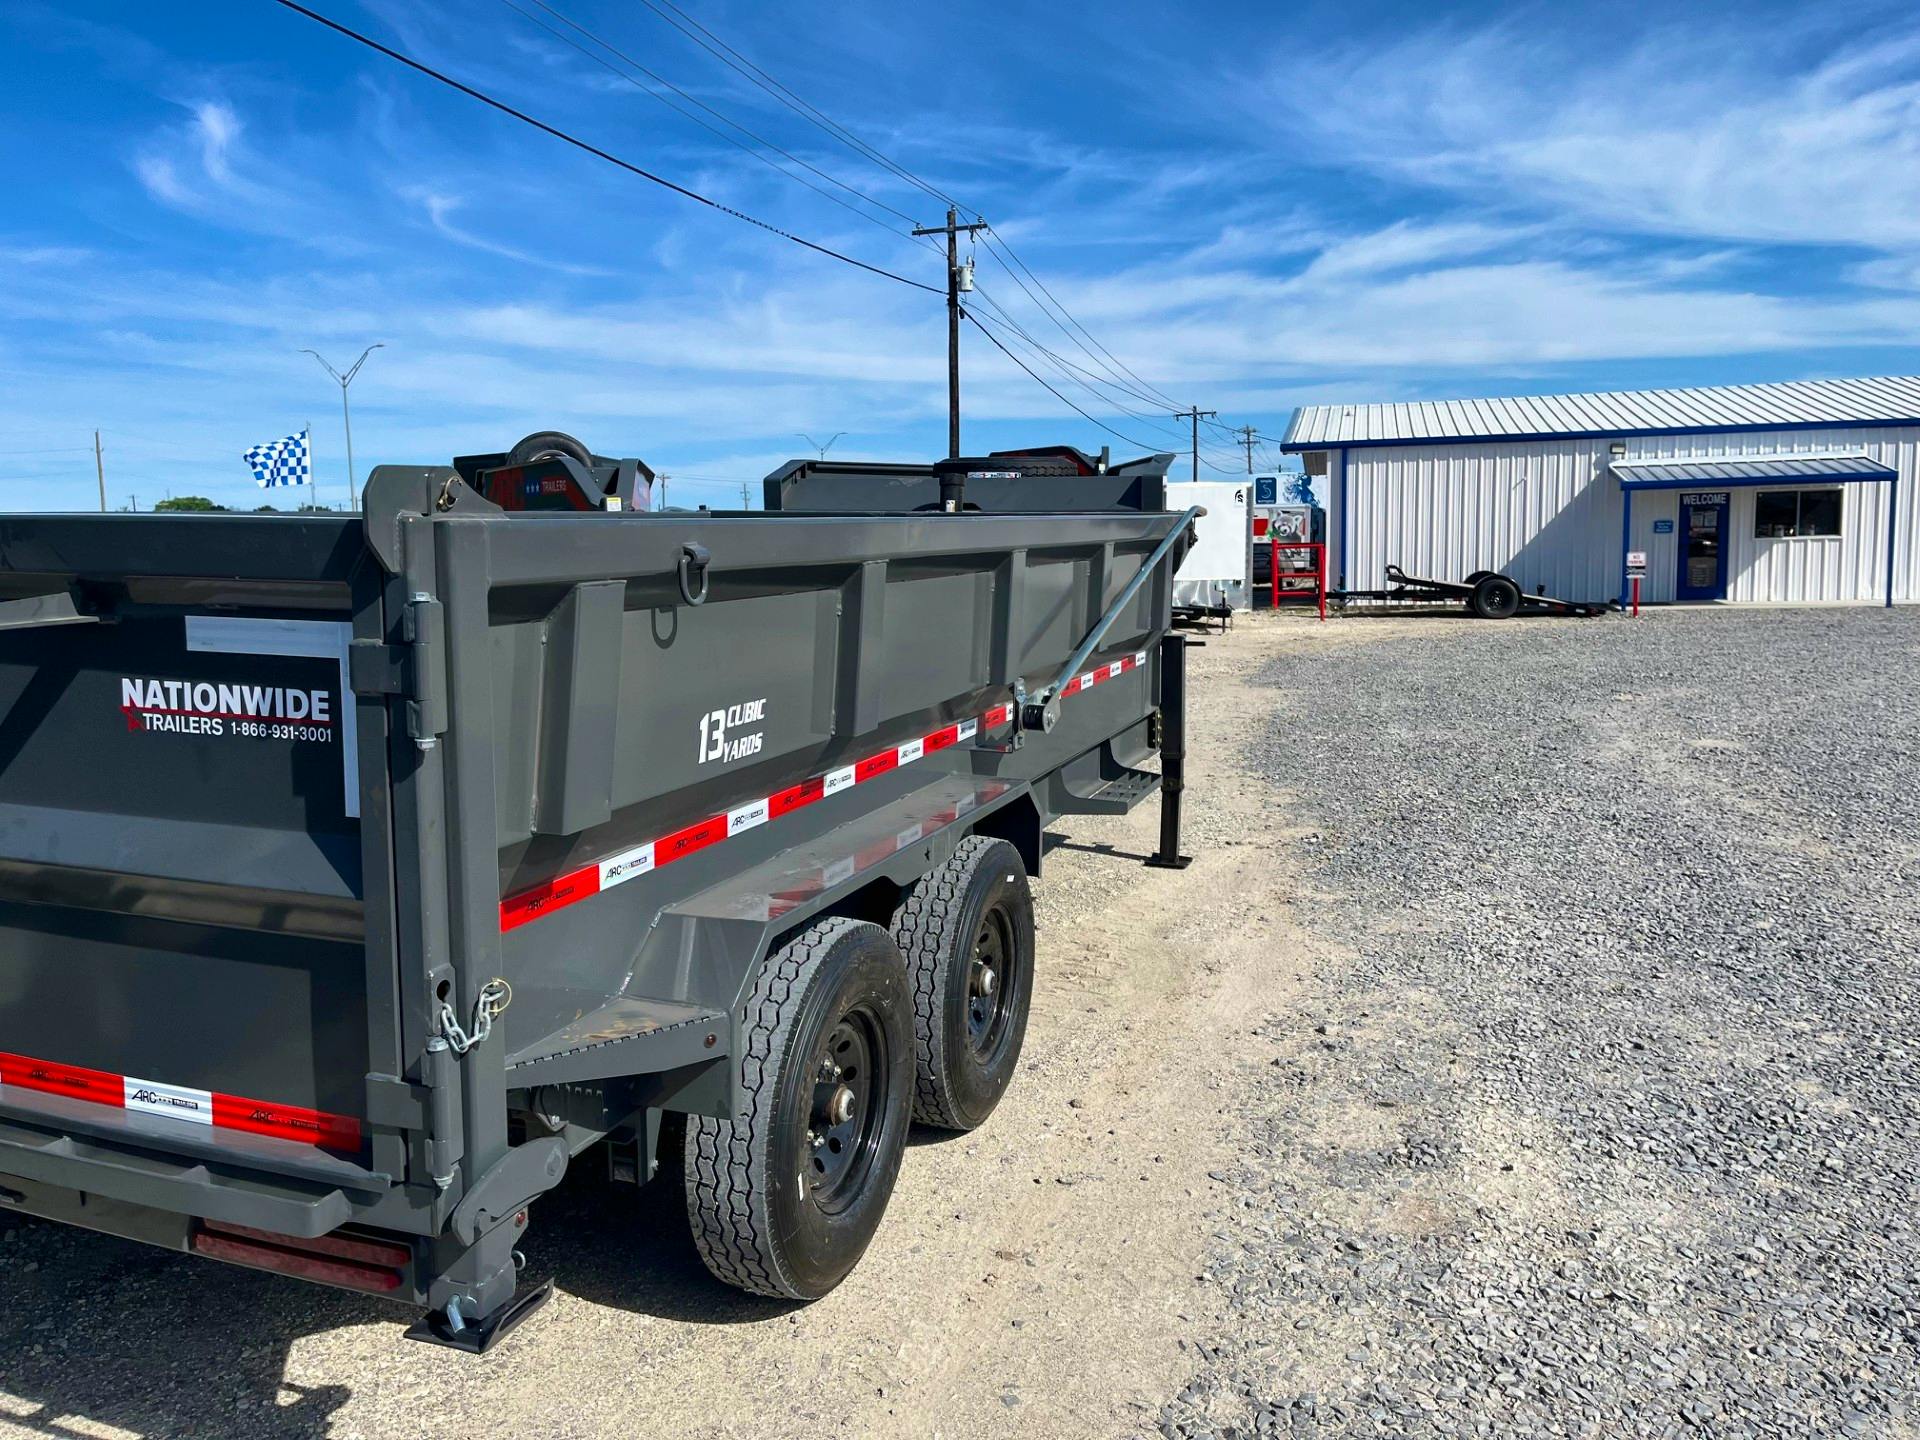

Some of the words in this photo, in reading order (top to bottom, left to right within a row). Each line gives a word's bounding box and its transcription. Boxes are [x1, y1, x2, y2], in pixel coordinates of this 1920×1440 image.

[1682, 493, 1727, 505] WELCOME
[121, 677, 331, 722] NATIONWIDE
[142, 712, 224, 736] TRAILERS
[230, 721, 332, 743] 1-866-931-3001
[698, 709, 726, 764] 13
[726, 698, 767, 728] CUBIC
[723, 731, 764, 764] YARDS
[605, 864, 622, 879] ARC
[131, 1089, 157, 1104] ARC
[248, 1108, 274, 1124] ARC
